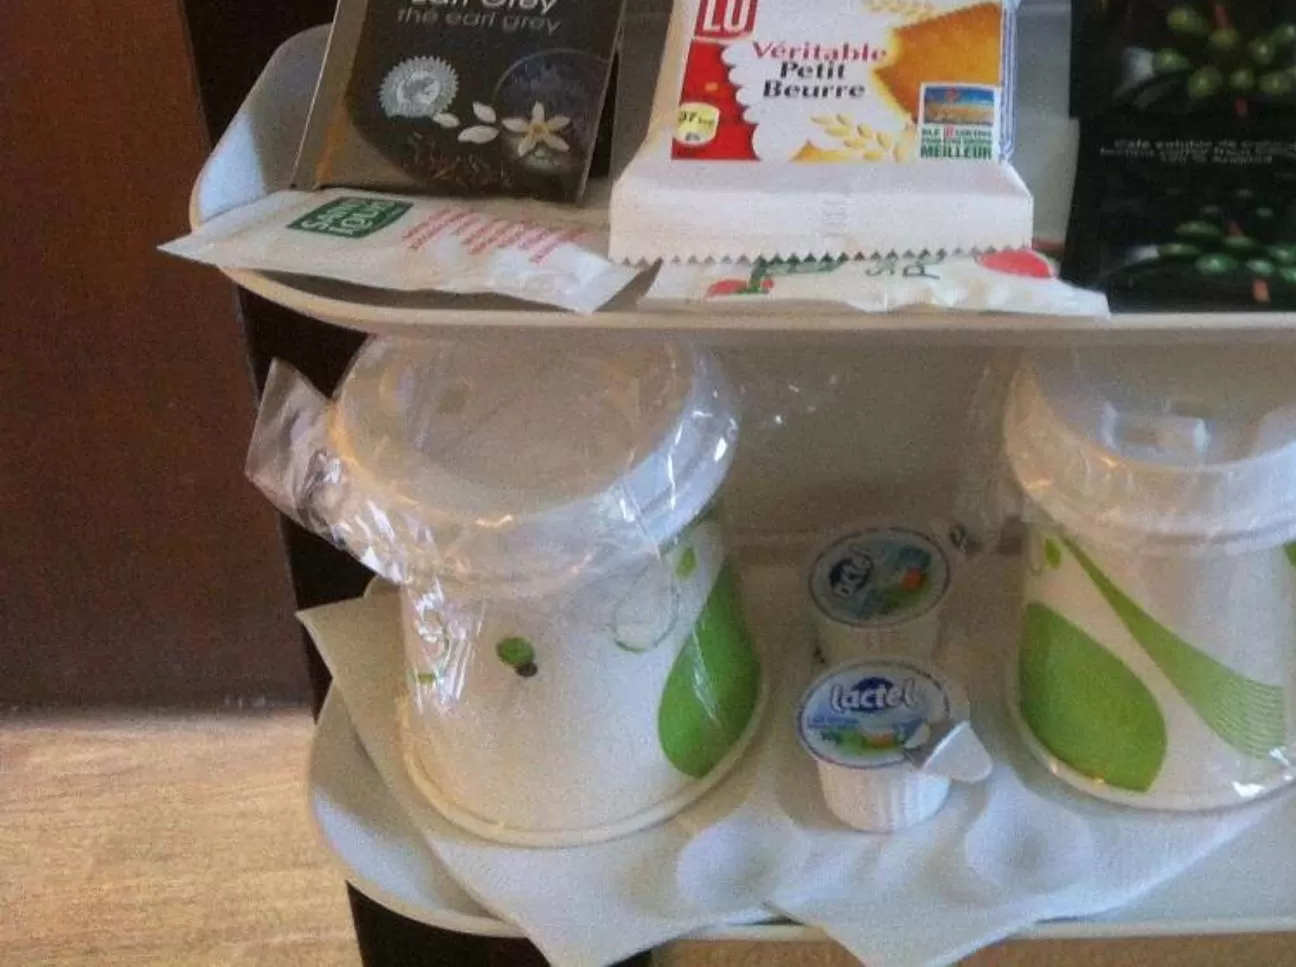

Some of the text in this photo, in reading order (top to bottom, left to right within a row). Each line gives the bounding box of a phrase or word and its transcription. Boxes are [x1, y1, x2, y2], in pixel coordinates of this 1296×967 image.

[446, 11, 496, 28] earl
[502, 15, 561, 36] grey
[752, 41, 887, 63] Véritable
[780, 62, 845, 80] Petit
[763, 79, 866, 99] Beurre
[920, 145, 992, 160] MEILLEUR
